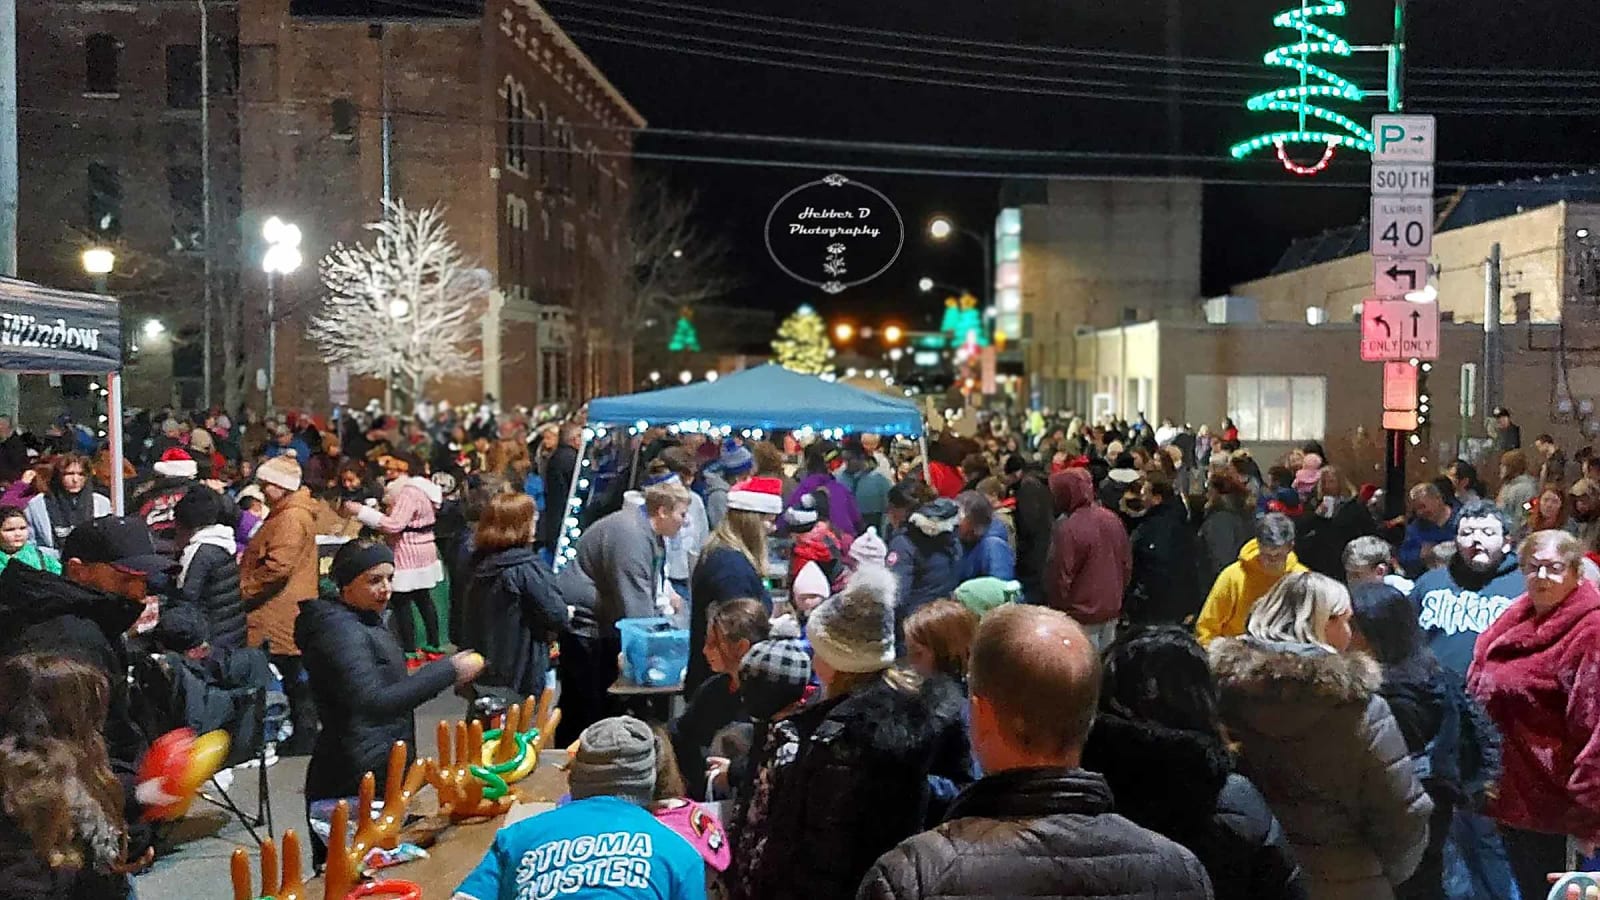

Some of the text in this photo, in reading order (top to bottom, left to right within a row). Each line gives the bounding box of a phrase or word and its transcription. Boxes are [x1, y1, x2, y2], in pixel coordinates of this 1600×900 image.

[1377, 171, 1429, 188] SOUTH
[1381, 205, 1423, 215] ILLINOIS
[1381, 221, 1424, 247] 40
[1369, 340, 1398, 352] ONLY
[1403, 340, 1432, 352] ONLY
[516, 832, 652, 884] STIGMA
